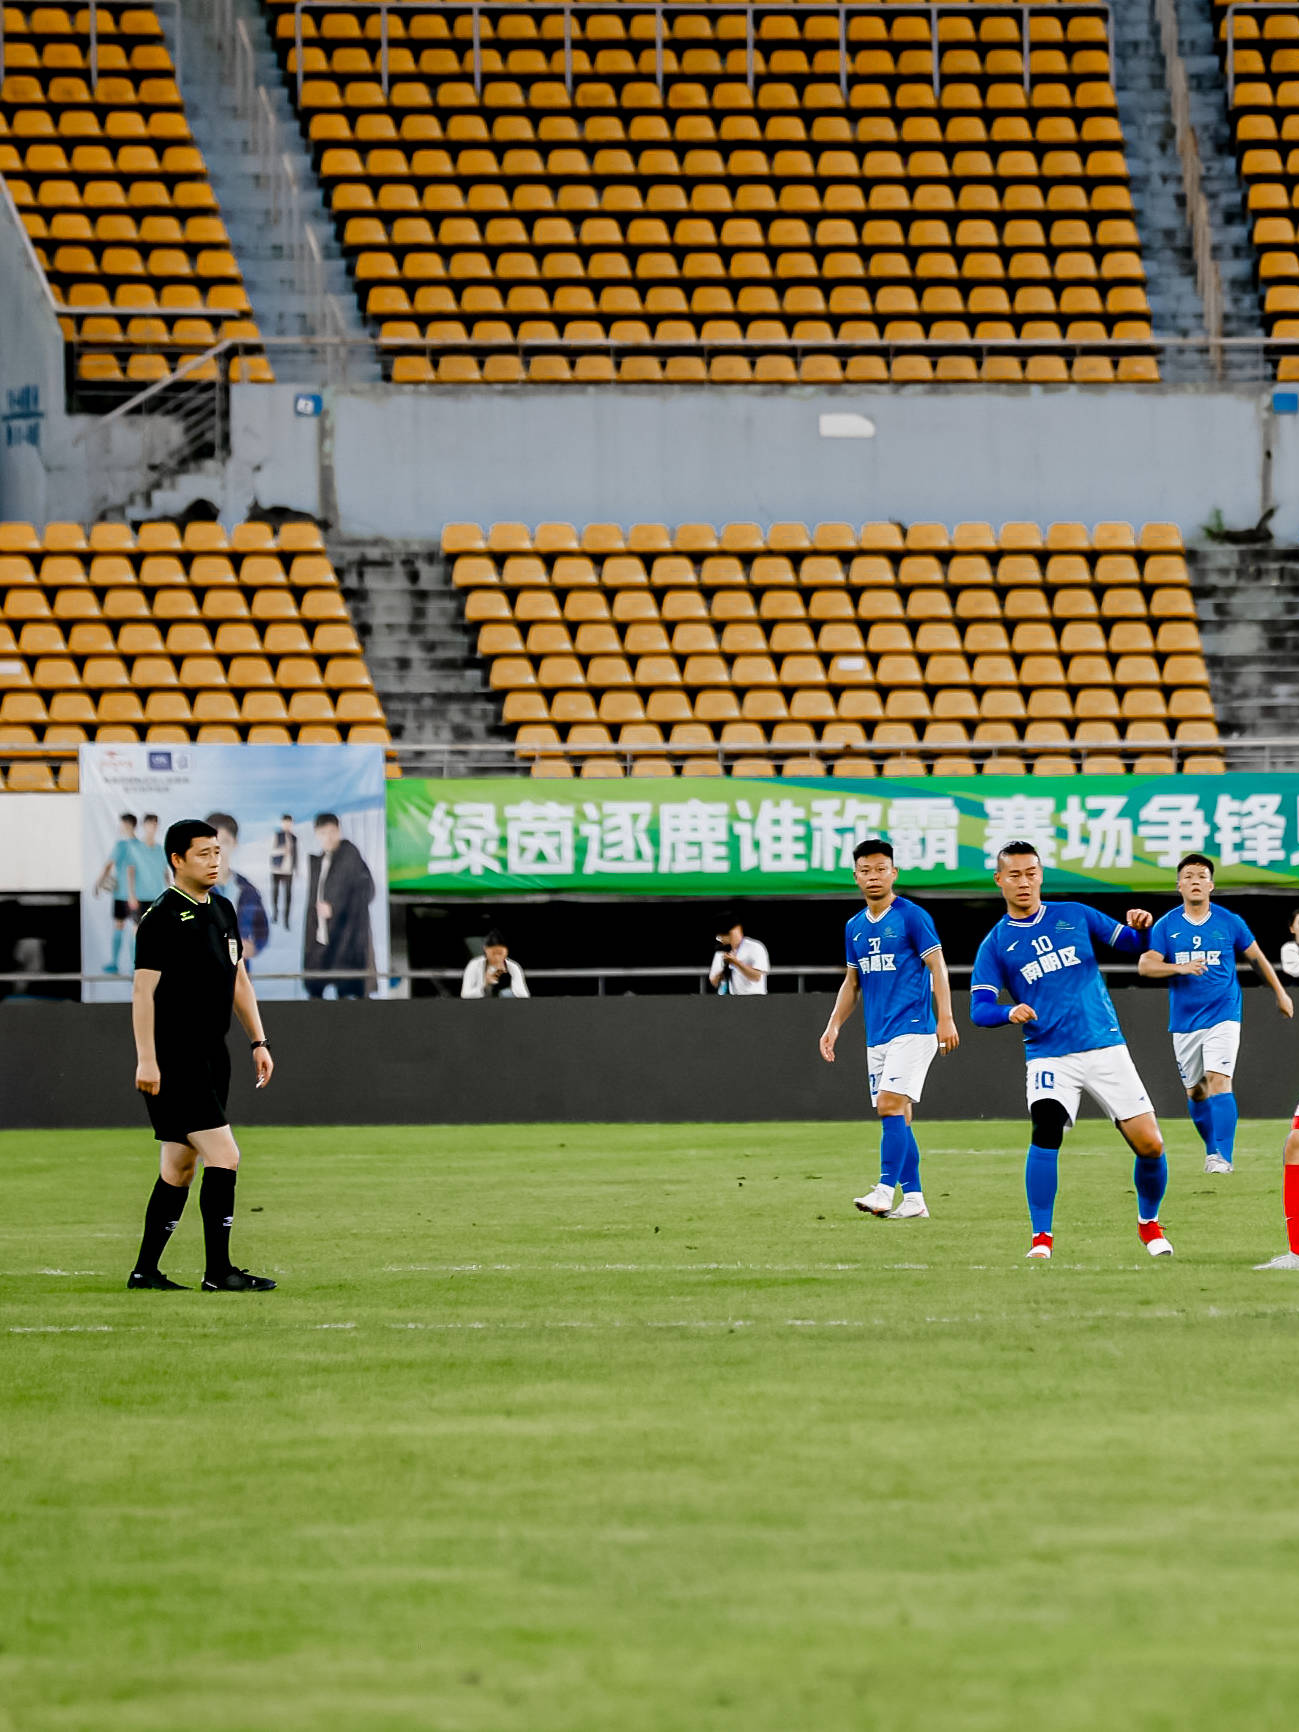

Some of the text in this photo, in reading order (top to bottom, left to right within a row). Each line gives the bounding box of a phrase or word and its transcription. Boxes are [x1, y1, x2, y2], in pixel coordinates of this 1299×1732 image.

[427, 796, 959, 875] 绿茵逐鹿谁称霸
[1031, 935, 1054, 956] 10
[1192, 935, 1202, 950] 9
[1020, 945, 1082, 985] 南明区
[1034, 1070, 1055, 1090] 10
